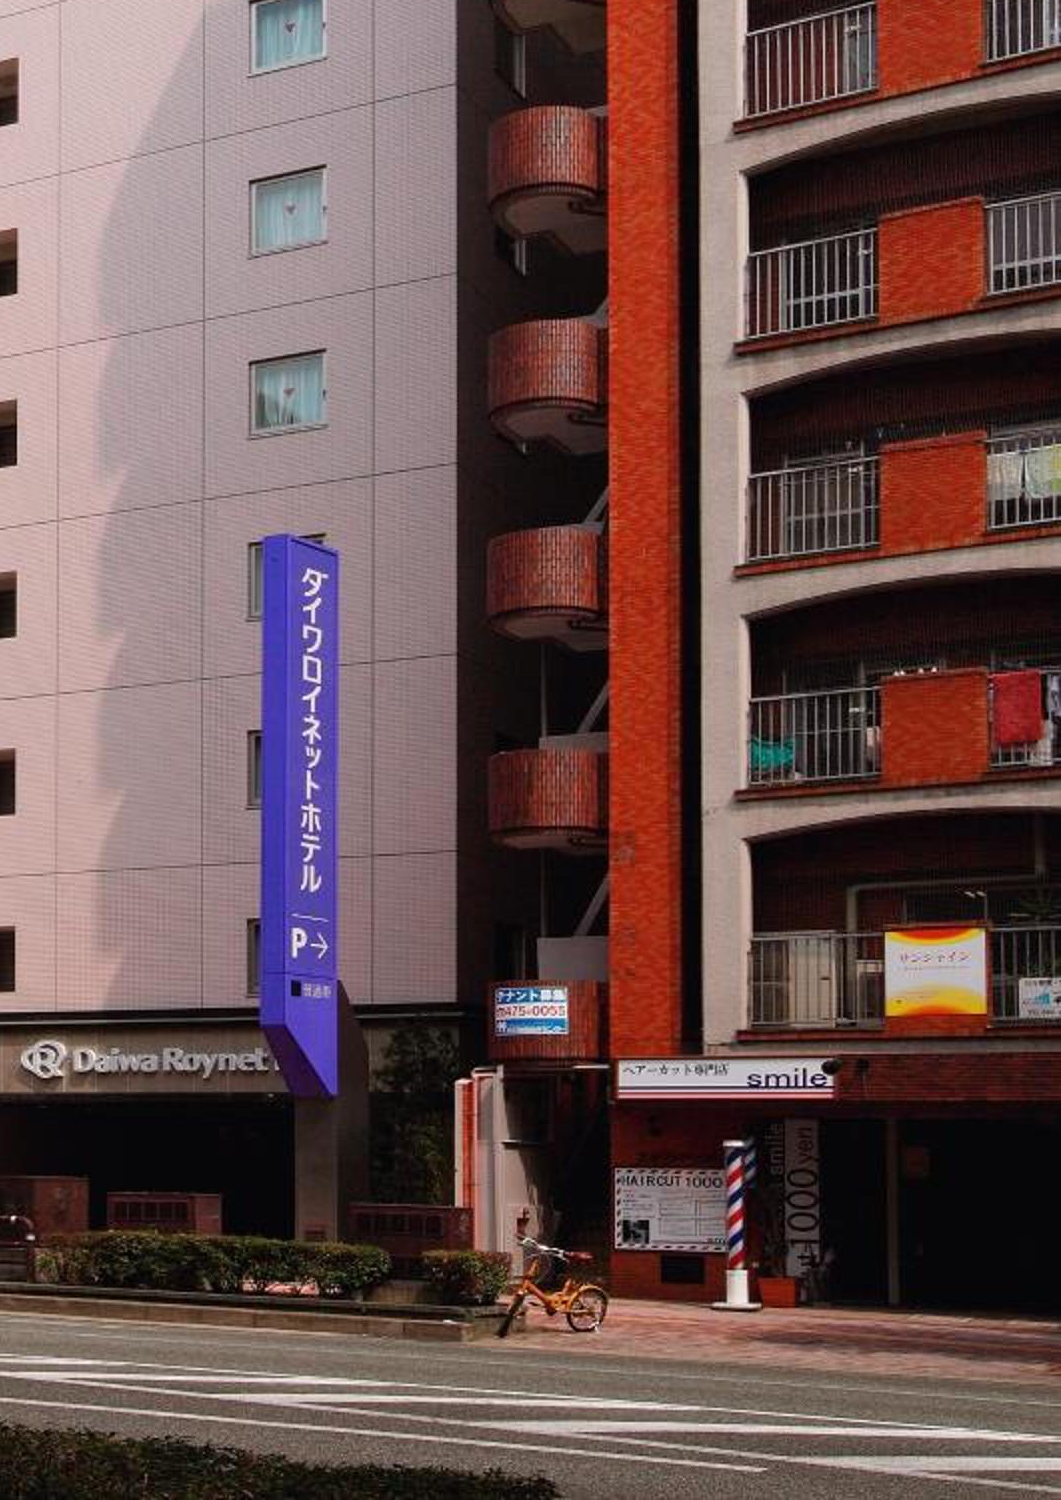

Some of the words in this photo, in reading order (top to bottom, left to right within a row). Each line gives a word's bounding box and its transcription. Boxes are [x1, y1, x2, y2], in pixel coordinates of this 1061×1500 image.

[301, 568, 329, 893] ダイワロイネットホテル
[291, 927, 307, 958] P
[73, 1048, 160, 1072] Daiwa
[162, 1047, 268, 1079] Roynet
[747, 1068, 827, 1089] smile
